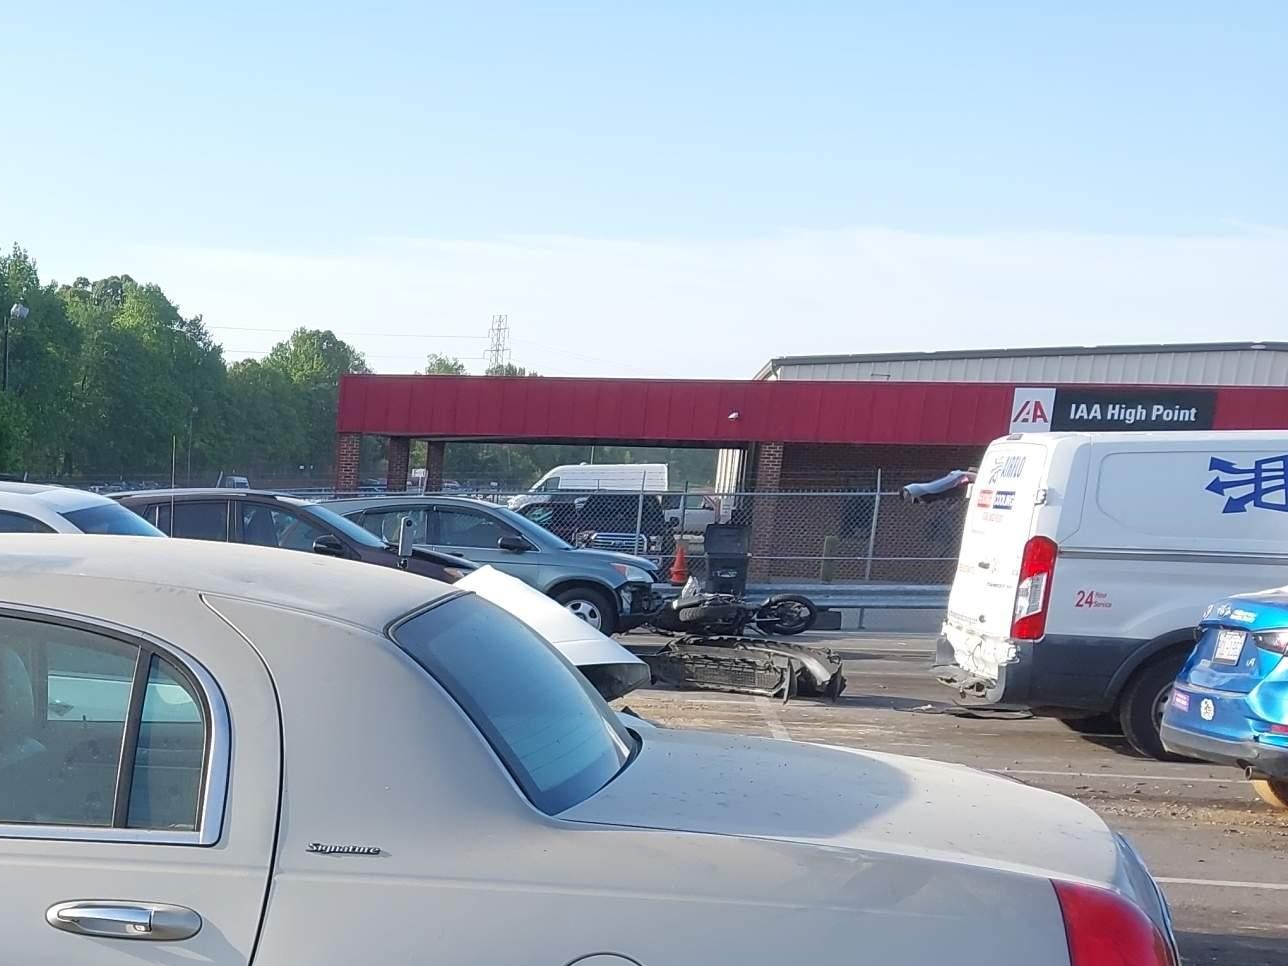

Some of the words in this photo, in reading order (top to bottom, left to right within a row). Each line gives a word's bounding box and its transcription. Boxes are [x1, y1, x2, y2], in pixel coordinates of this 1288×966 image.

[1069, 403, 1102, 421] IAA
[1106, 404, 1146, 424] High
[1151, 404, 1198, 422] Point
[1075, 590, 1094, 608] 24
[305, 842, 382, 856] Signature
